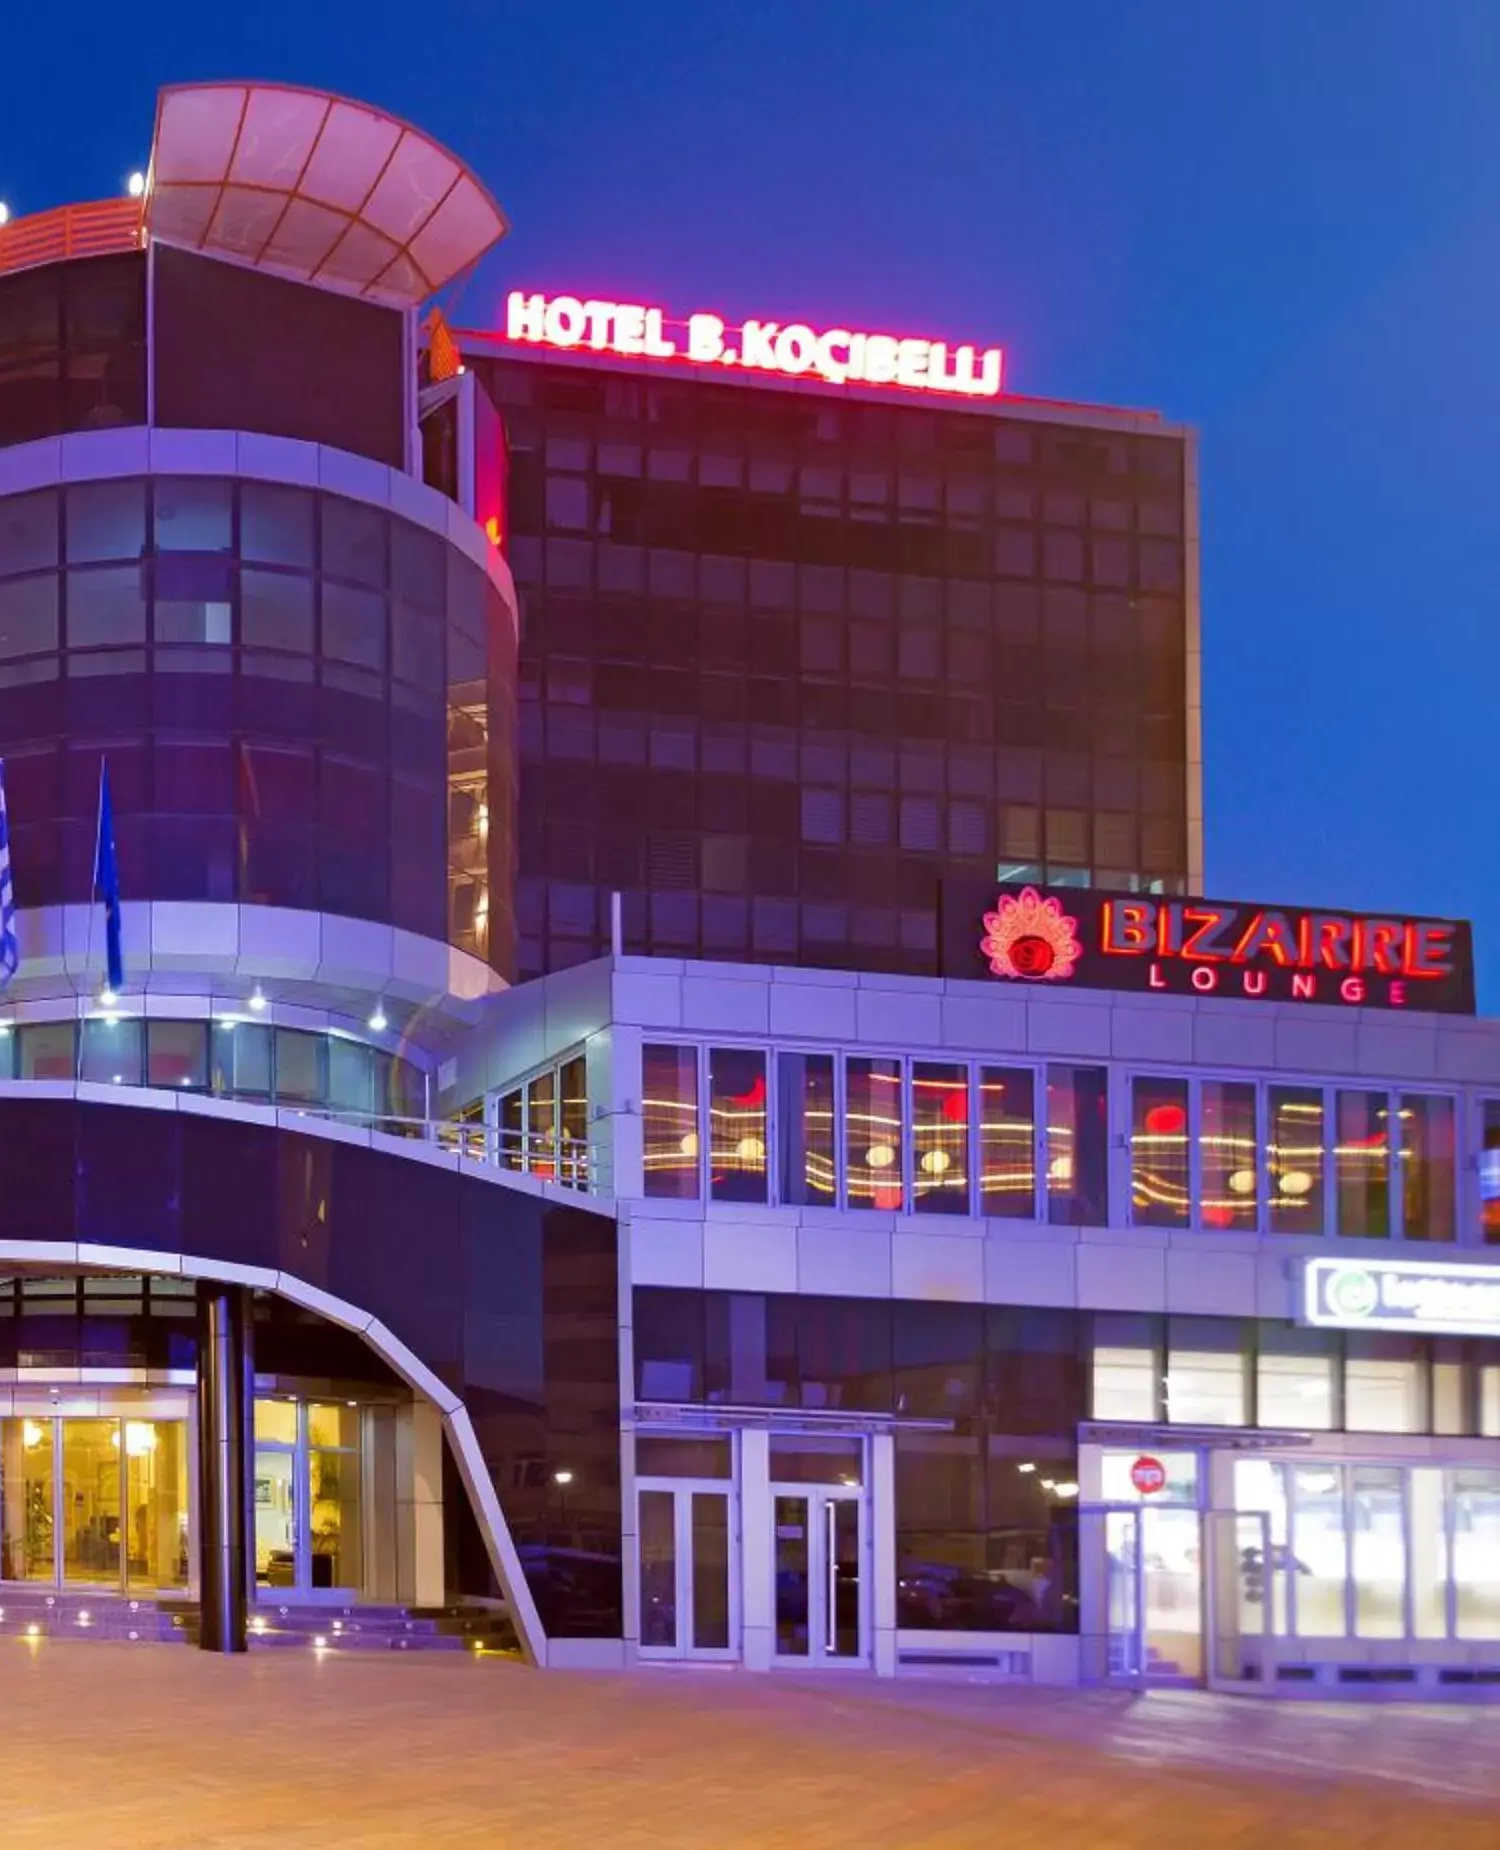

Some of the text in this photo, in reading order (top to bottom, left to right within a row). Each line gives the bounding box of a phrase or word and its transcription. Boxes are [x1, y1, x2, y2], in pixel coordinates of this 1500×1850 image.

[507, 291, 675, 357] HOTEL
[1102, 900, 1456, 978] BIZARRE
[1151, 964, 1406, 1003] LOUNGE
